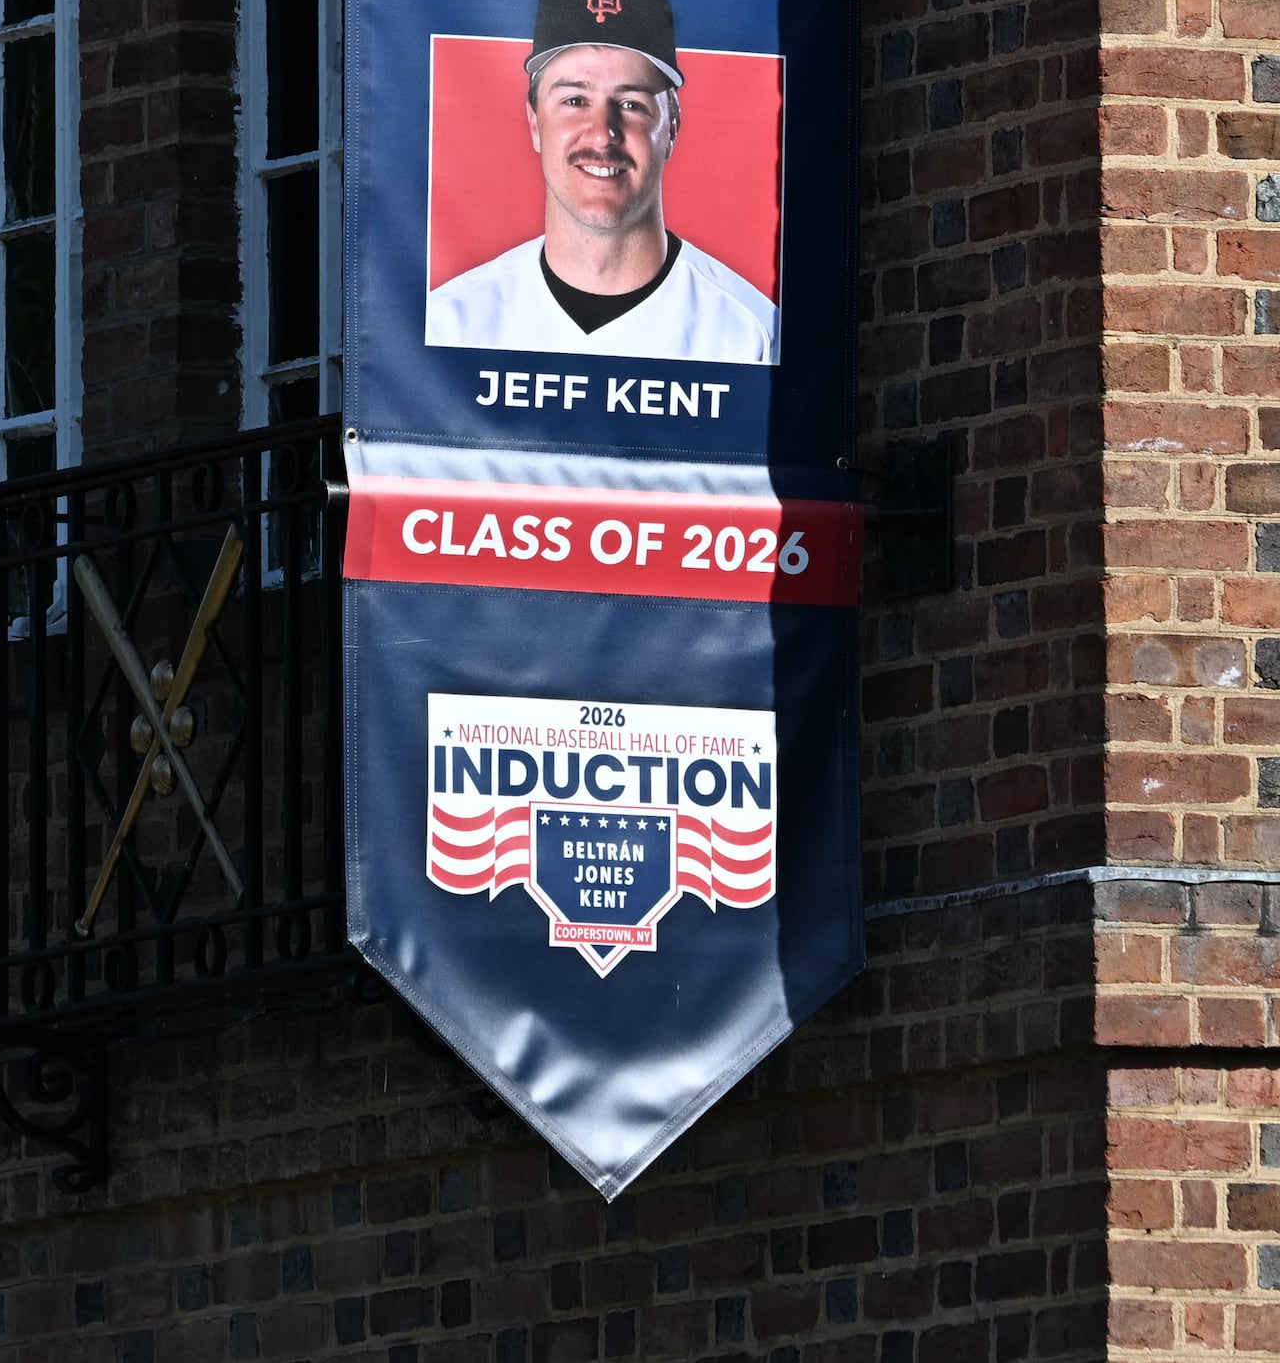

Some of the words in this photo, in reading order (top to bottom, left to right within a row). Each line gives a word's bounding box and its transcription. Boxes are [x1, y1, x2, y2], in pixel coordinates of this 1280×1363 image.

[476, 370, 589, 410] JEFF
[606, 377, 730, 419] KENT
[402, 509, 573, 562] CLASS
[590, 520, 666, 566] OF
[681, 526, 810, 575] 2026
[580, 706, 626, 727] 2026
[459, 724, 543, 746] NATIONAL
[546, 728, 626, 751] BASEBALL
[630, 733, 671, 753] HALL
[675, 735, 698, 755] OF
[702, 736, 746, 757] FAME
[434, 745, 771, 809] INDUCTION
[563, 840, 644, 862] BELTRÁN
[574, 865, 634, 885] JONES
[580, 889, 627, 908] KENT
[555, 927, 634, 943] COOPERSTOWN,
[637, 931, 651, 943] NY
